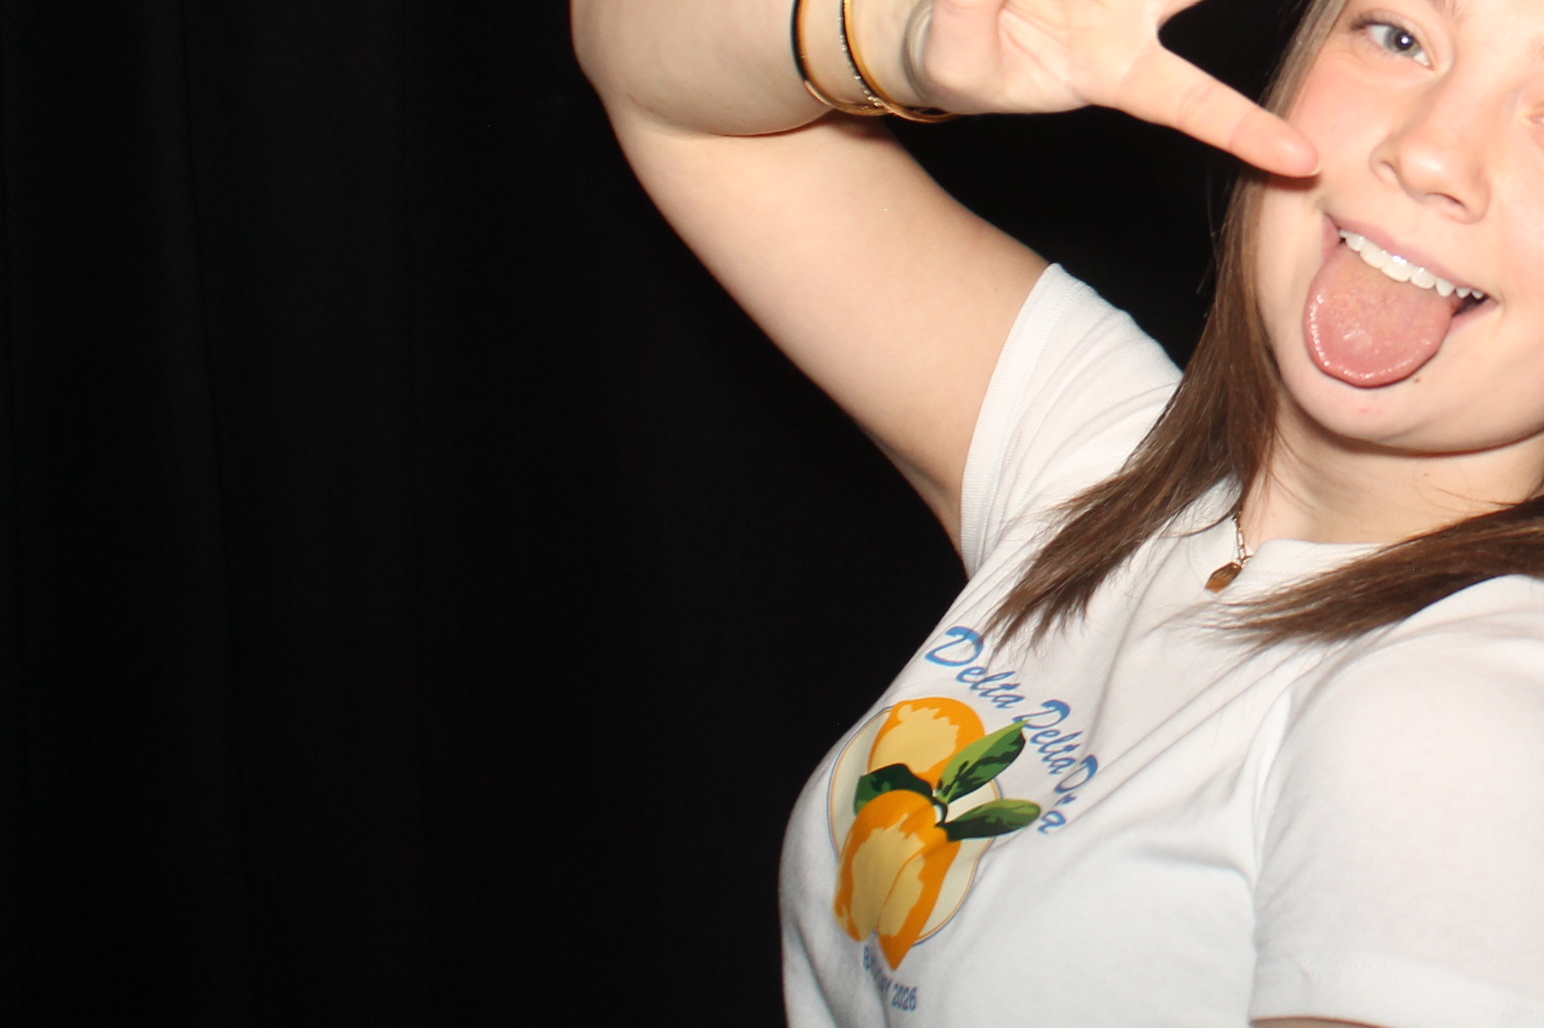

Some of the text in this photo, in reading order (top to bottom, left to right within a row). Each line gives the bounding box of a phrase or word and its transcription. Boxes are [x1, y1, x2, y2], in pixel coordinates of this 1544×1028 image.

[925, 626, 1026, 709] Delta
[1012, 699, 1083, 775] Delta
[891, 983, 917, 1011] 2026
